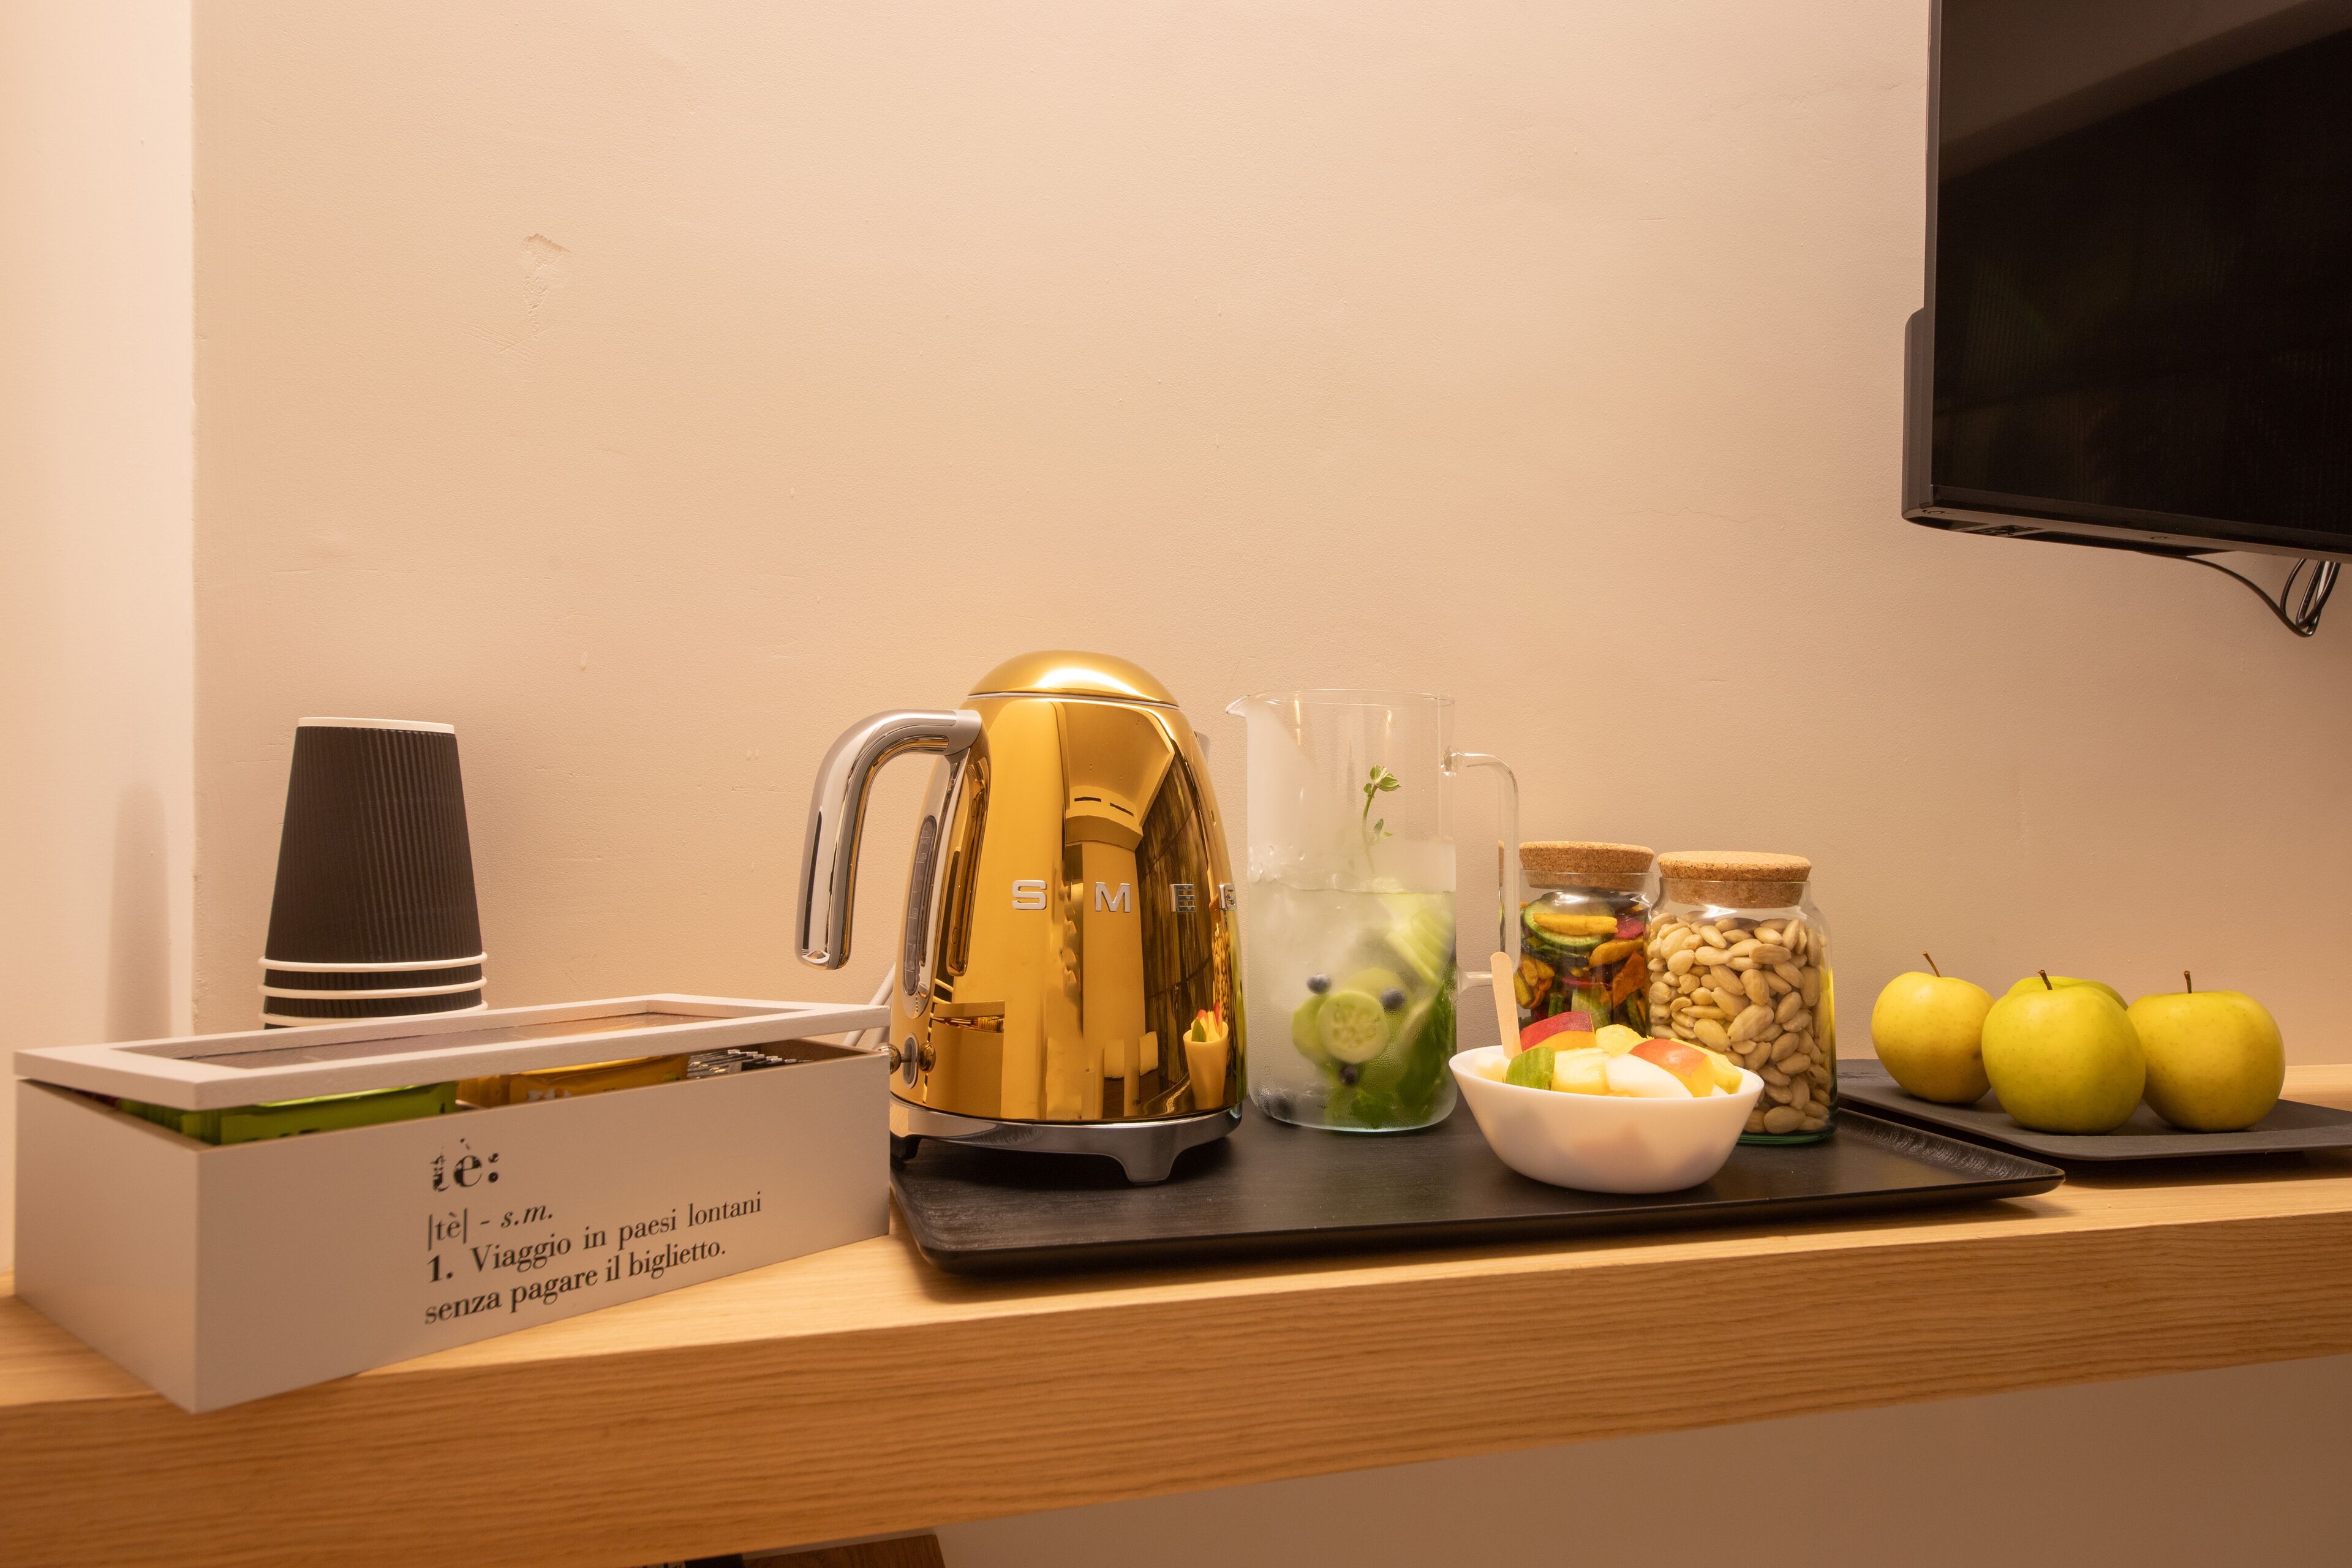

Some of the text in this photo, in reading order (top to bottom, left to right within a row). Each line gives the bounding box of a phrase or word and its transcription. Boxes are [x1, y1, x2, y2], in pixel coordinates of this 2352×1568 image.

[427, 1191, 761, 1283] 1. Viaggio in paesi lontani
[500, 1204, 553, 1229] s.m.
[424, 1241, 726, 1325] senza pagare il biglietto.
